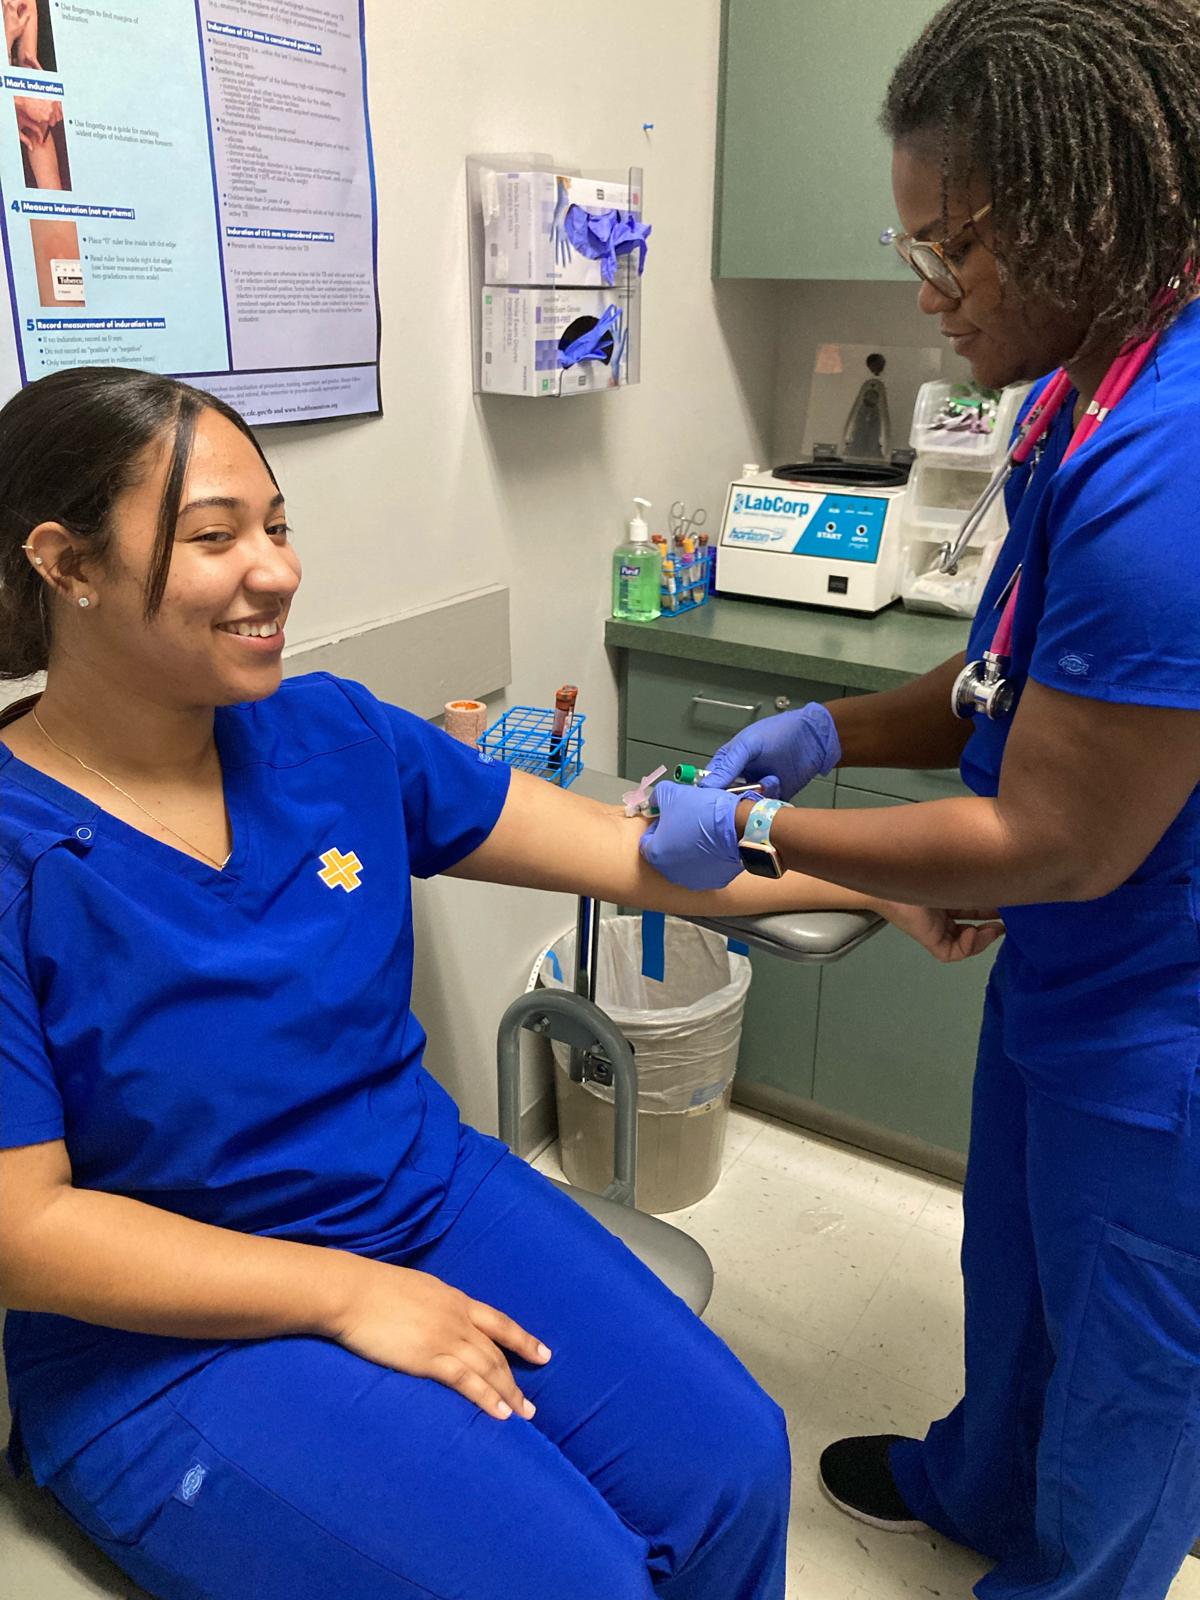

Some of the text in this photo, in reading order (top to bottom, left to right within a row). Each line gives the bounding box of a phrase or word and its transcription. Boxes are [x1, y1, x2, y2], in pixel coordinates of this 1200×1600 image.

[61, 2, 70, 11] Use
[208, 22, 236, 35] Induration
[236, 28, 242, 37] of
[254, 31, 264, 41] mm
[270, 35, 296, 48] considered
[298, 40, 316, 52] positive
[6, 79, 26, 88] Mark
[26, 81, 63, 94] induration
[12, 200, 134, 218] 4 Measure induration (not erythema)
[228, 228, 254, 236] Induration
[272, 230, 282, 238] mm
[287, 231, 312, 239] considered
[312, 232, 330, 240] positive
[26, 318, 35, 330] 5
[63, 321, 105, 329] measurement
[106, 321, 113, 329] of
[114, 320, 145, 329] induration
[147, 320, 153, 328] in
[745, 494, 809, 517] LabCorp
[816, 531, 842, 540] START
